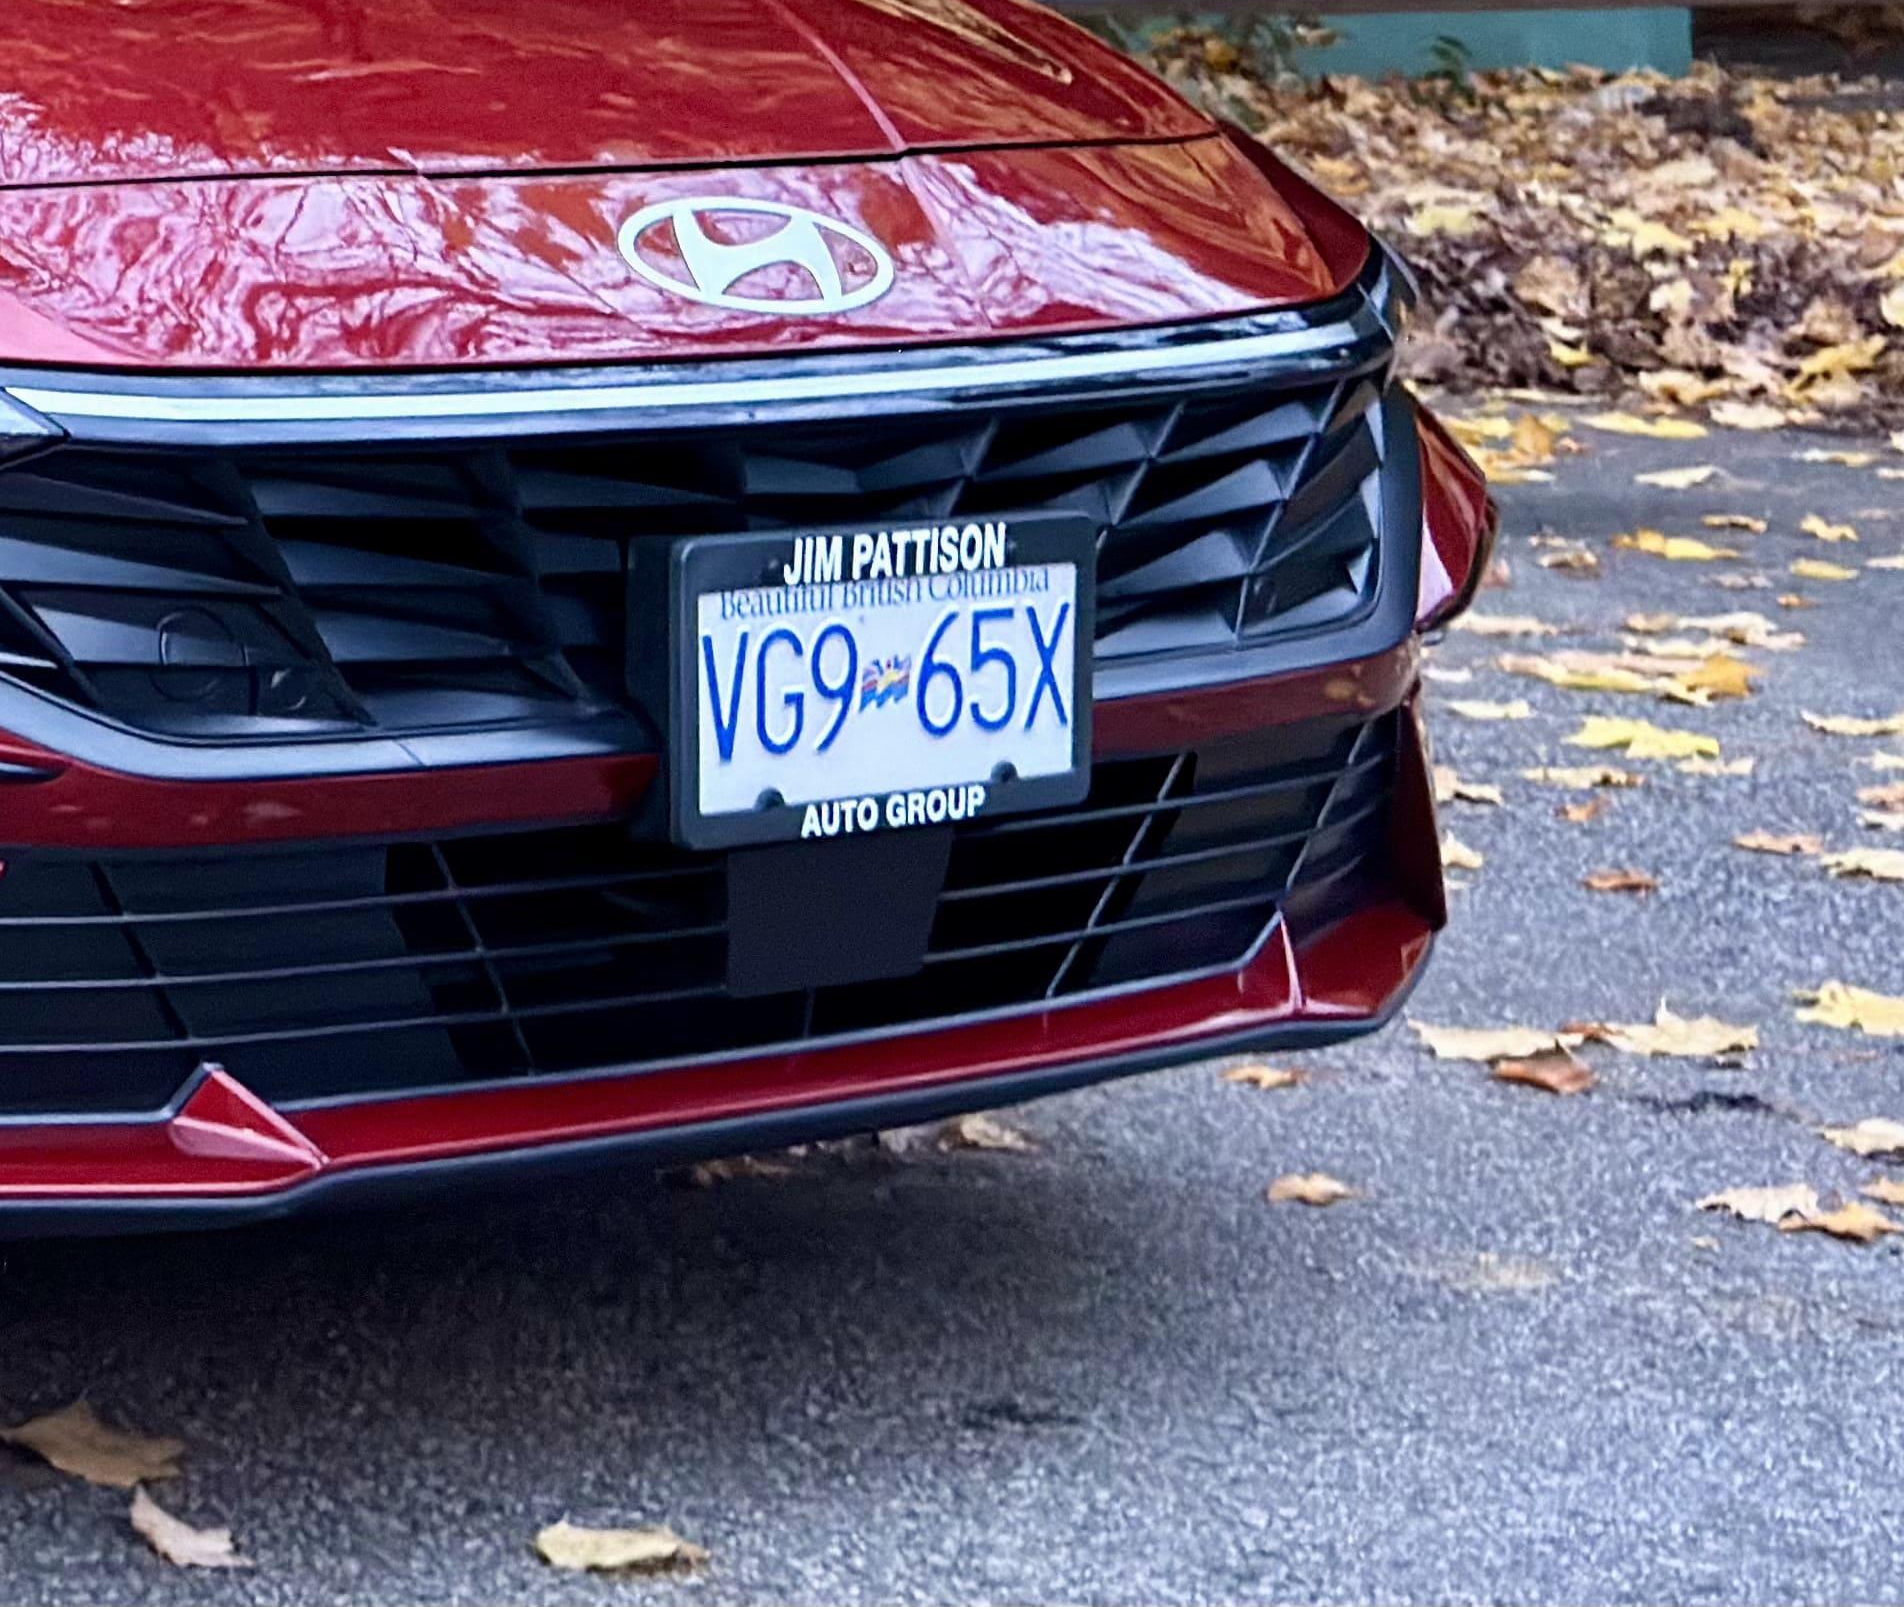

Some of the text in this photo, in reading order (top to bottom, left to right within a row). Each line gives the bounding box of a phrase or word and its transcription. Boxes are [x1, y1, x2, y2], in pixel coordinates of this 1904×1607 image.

[784, 521, 1007, 586] JIM PATTISON
[844, 577, 921, 609] British
[929, 567, 1049, 601] Columbia
[701, 600, 1070, 763] VG9 65X
[801, 784, 986, 840] AUTO GROUP
